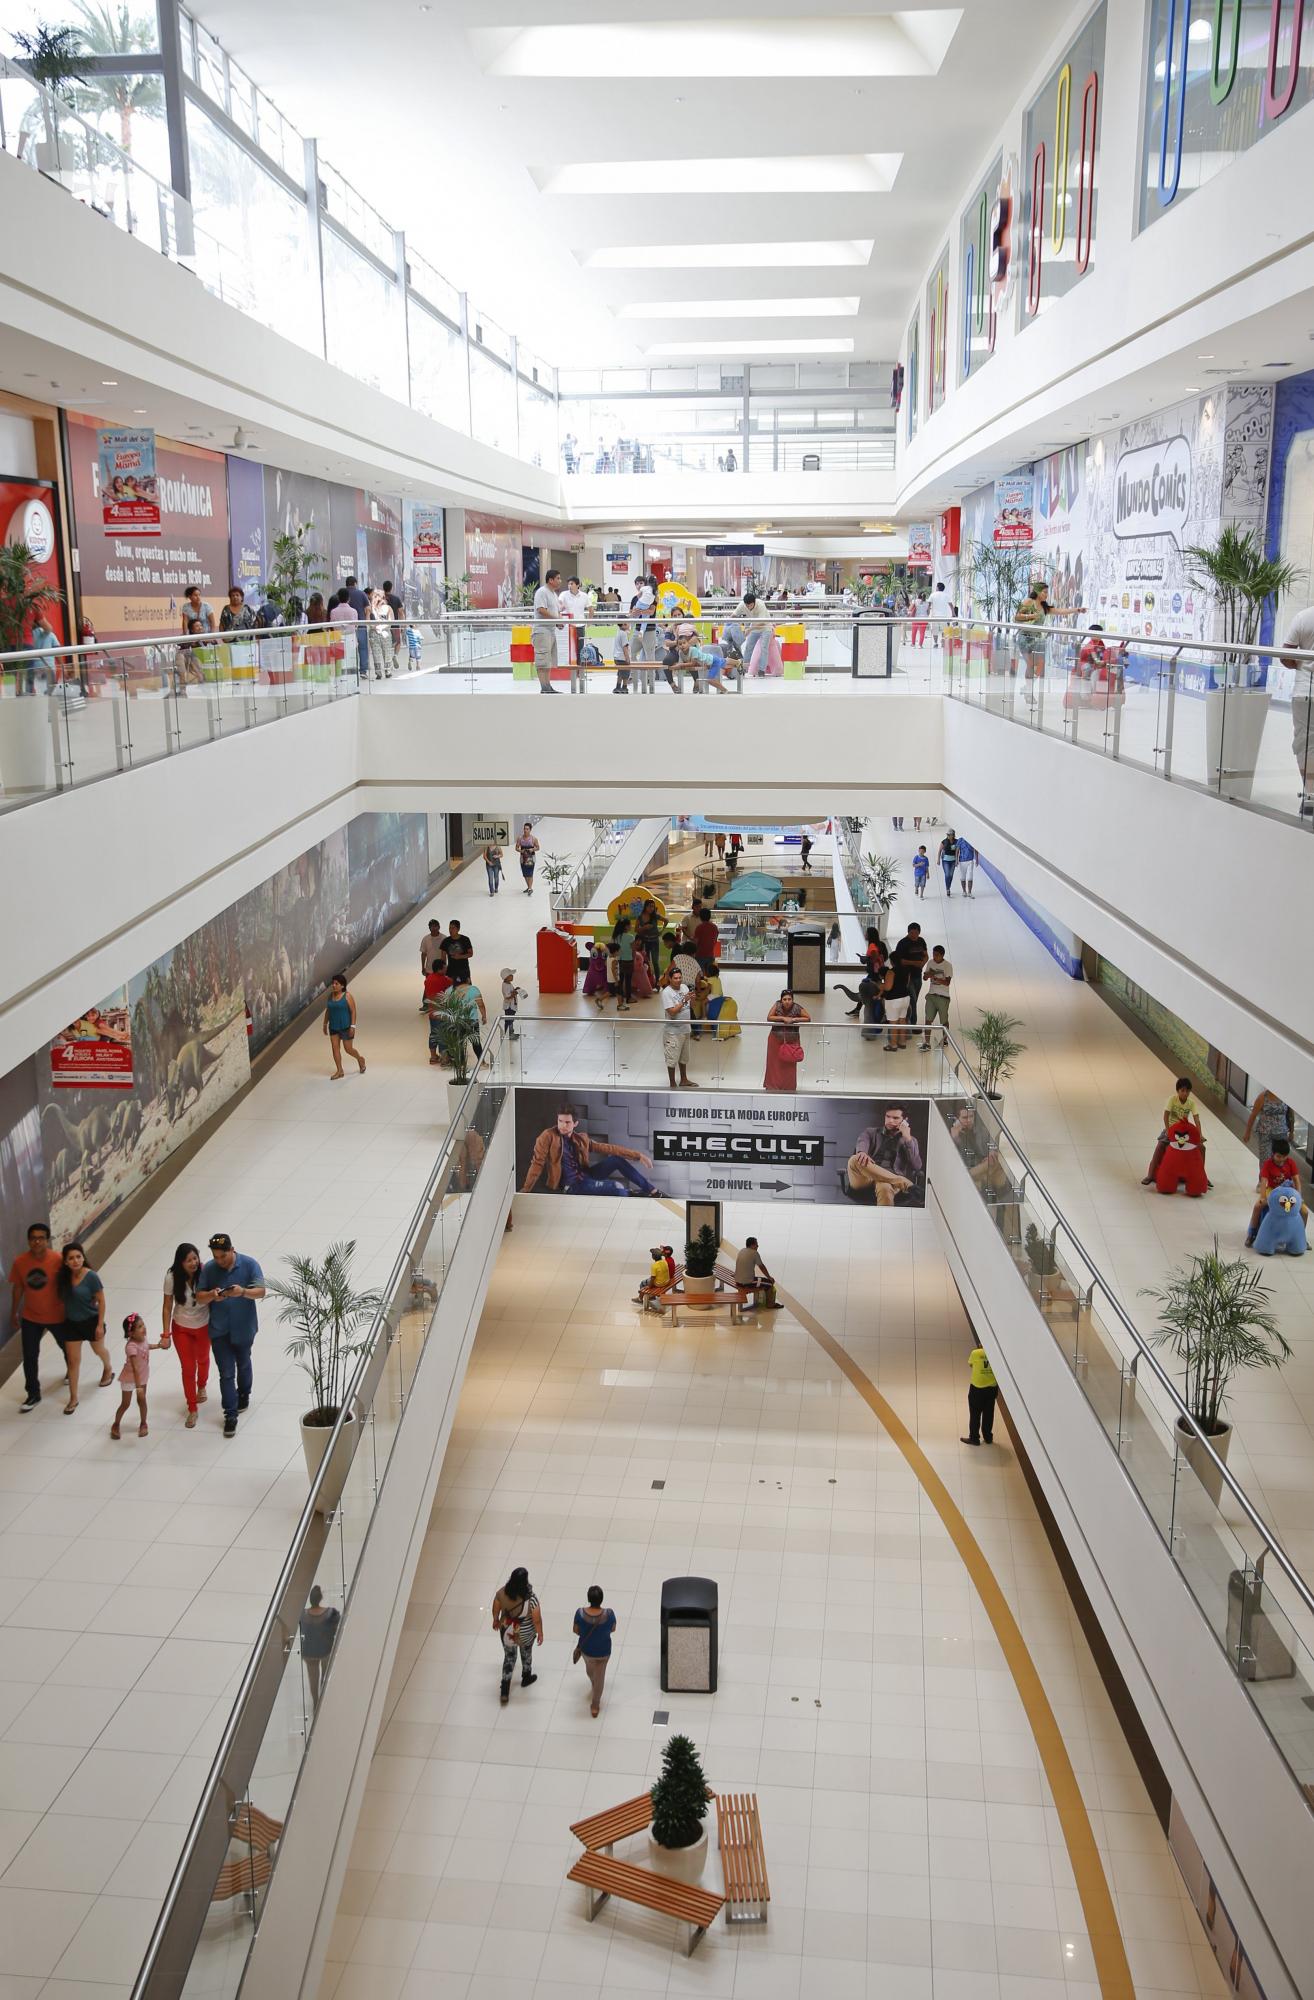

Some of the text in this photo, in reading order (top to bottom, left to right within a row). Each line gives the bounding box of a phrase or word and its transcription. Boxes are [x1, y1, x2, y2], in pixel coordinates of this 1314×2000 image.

[111, 504, 119, 517] 4
[115, 539, 135, 561] Show,
[473, 827, 495, 841] SALIDA
[62, 1046, 74, 1061] 4
[665, 1108, 810, 1122] LO MEJOR DE LA MODA EUROPEA
[656, 1135, 820, 1154] THECULT
[663, 1151, 734, 1159] SIGNATURE
[706, 1179, 753, 1191] 2DO NIVEL
